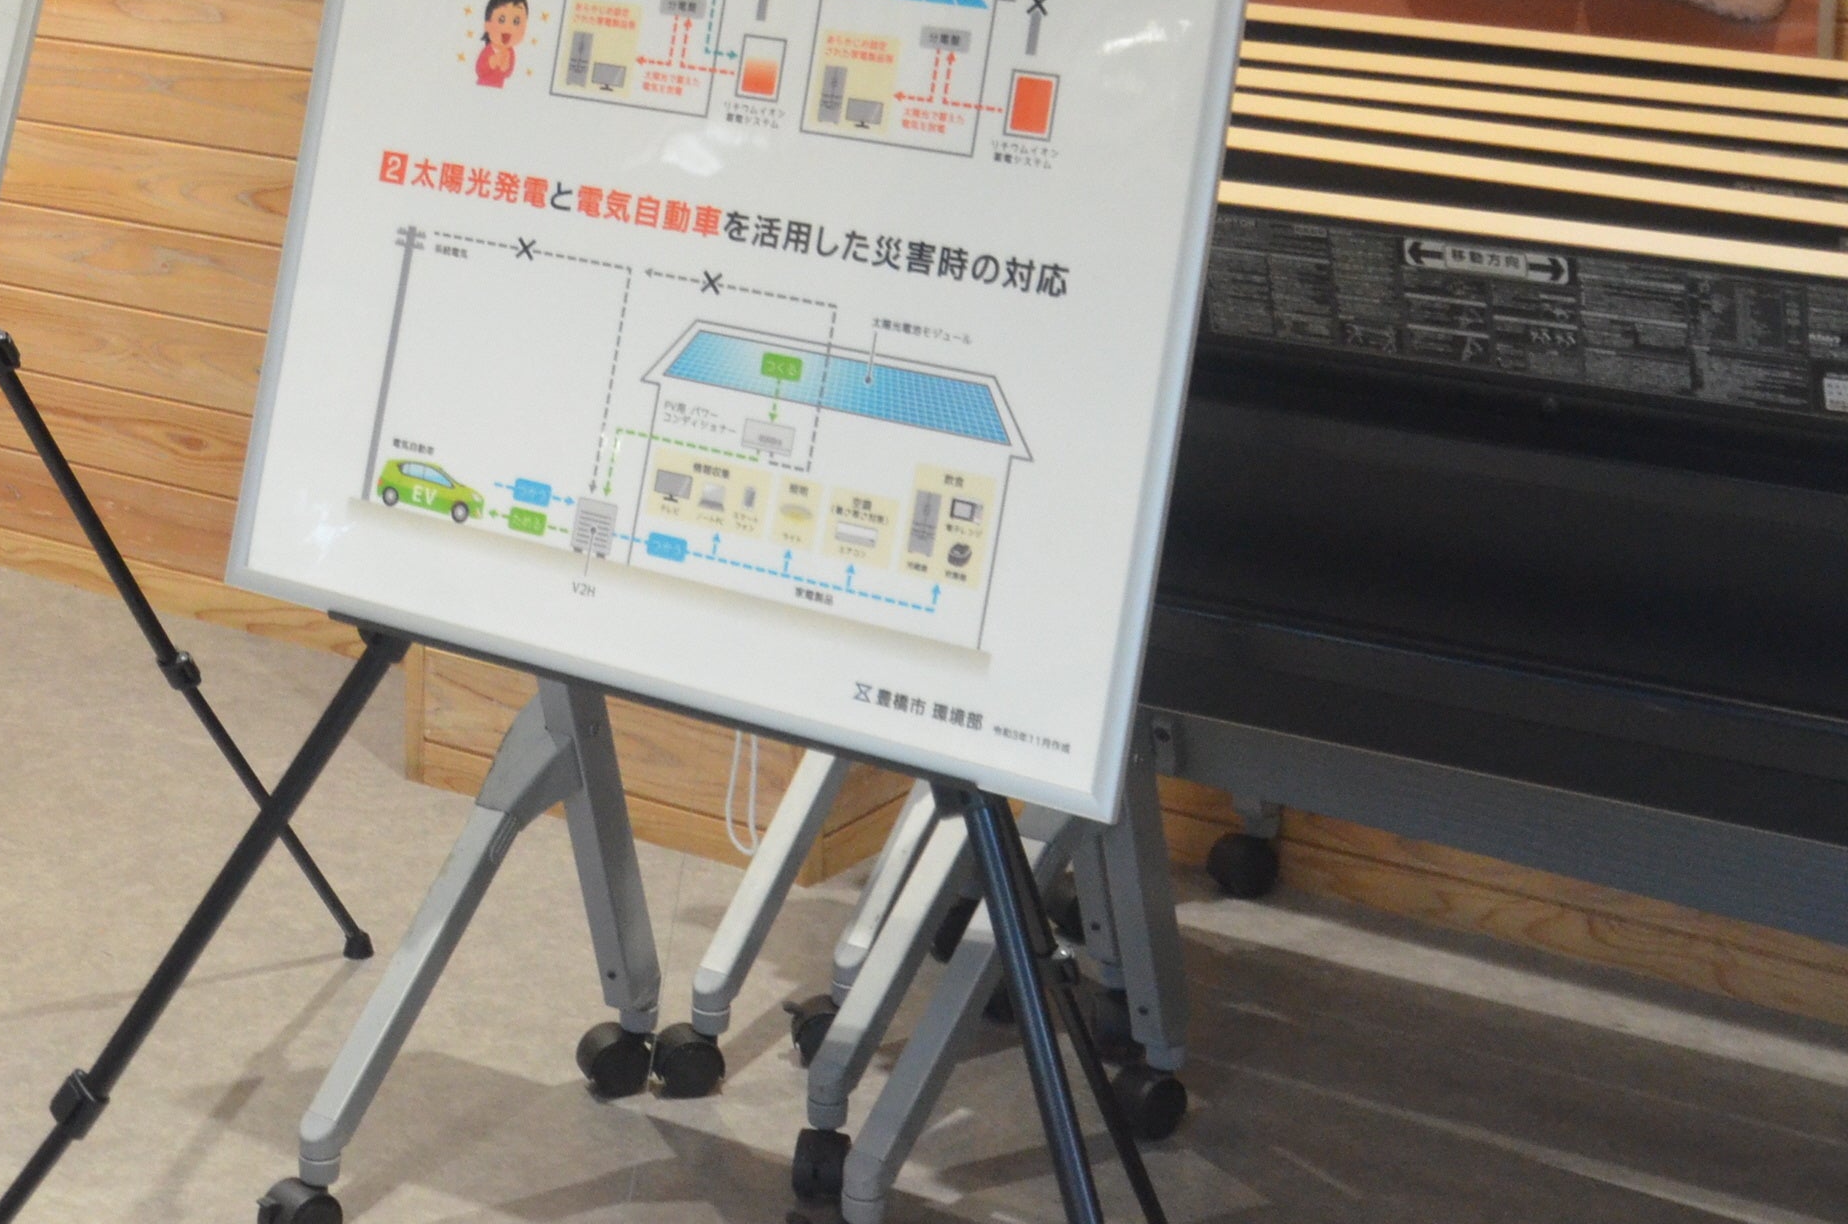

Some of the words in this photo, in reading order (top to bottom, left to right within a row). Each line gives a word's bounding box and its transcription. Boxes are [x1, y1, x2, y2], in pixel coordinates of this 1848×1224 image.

[411, 158, 1070, 297] 太陽光発電と電気自動車を活用した災害時の対応
[1451, 246, 1522, 272] 移動方向
[411, 485, 437, 506] EV
[571, 580, 596, 598] V2H
[876, 686, 927, 717] 豊橋市
[932, 701, 984, 732] 環境部
